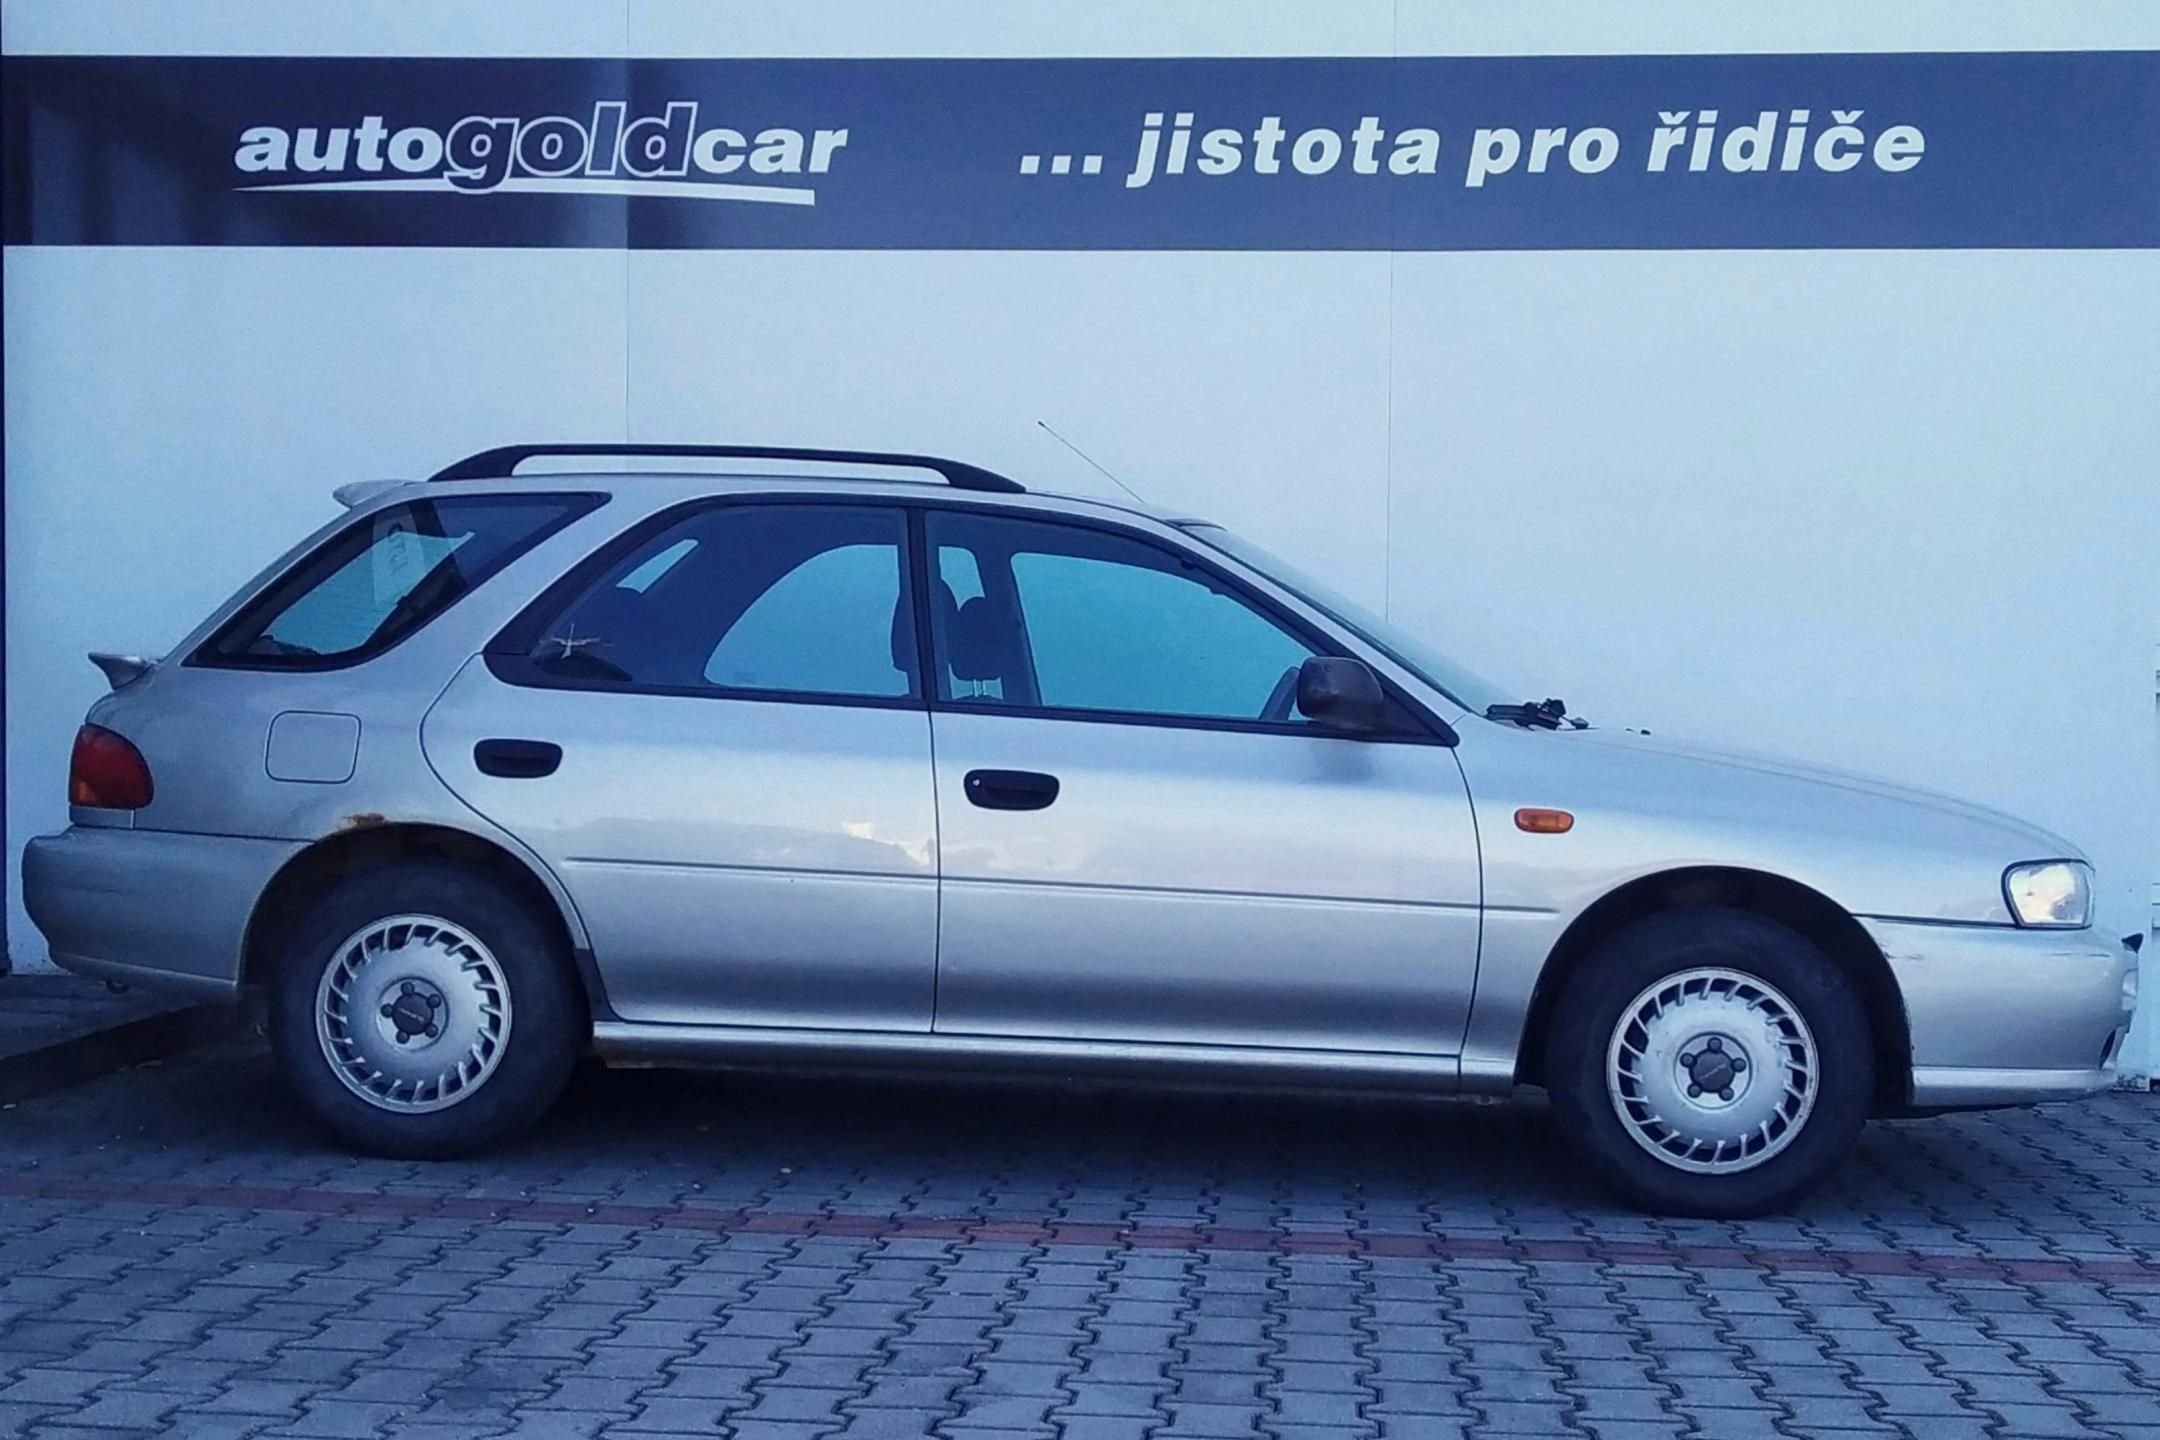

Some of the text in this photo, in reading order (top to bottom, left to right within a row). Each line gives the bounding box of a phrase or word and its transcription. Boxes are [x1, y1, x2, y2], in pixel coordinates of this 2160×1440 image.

[233, 101, 849, 195] autogoldcar
[1125, 112, 1440, 188] jistota
[1465, 127, 1619, 188] pro
[1646, 109, 1926, 174] řidiče
